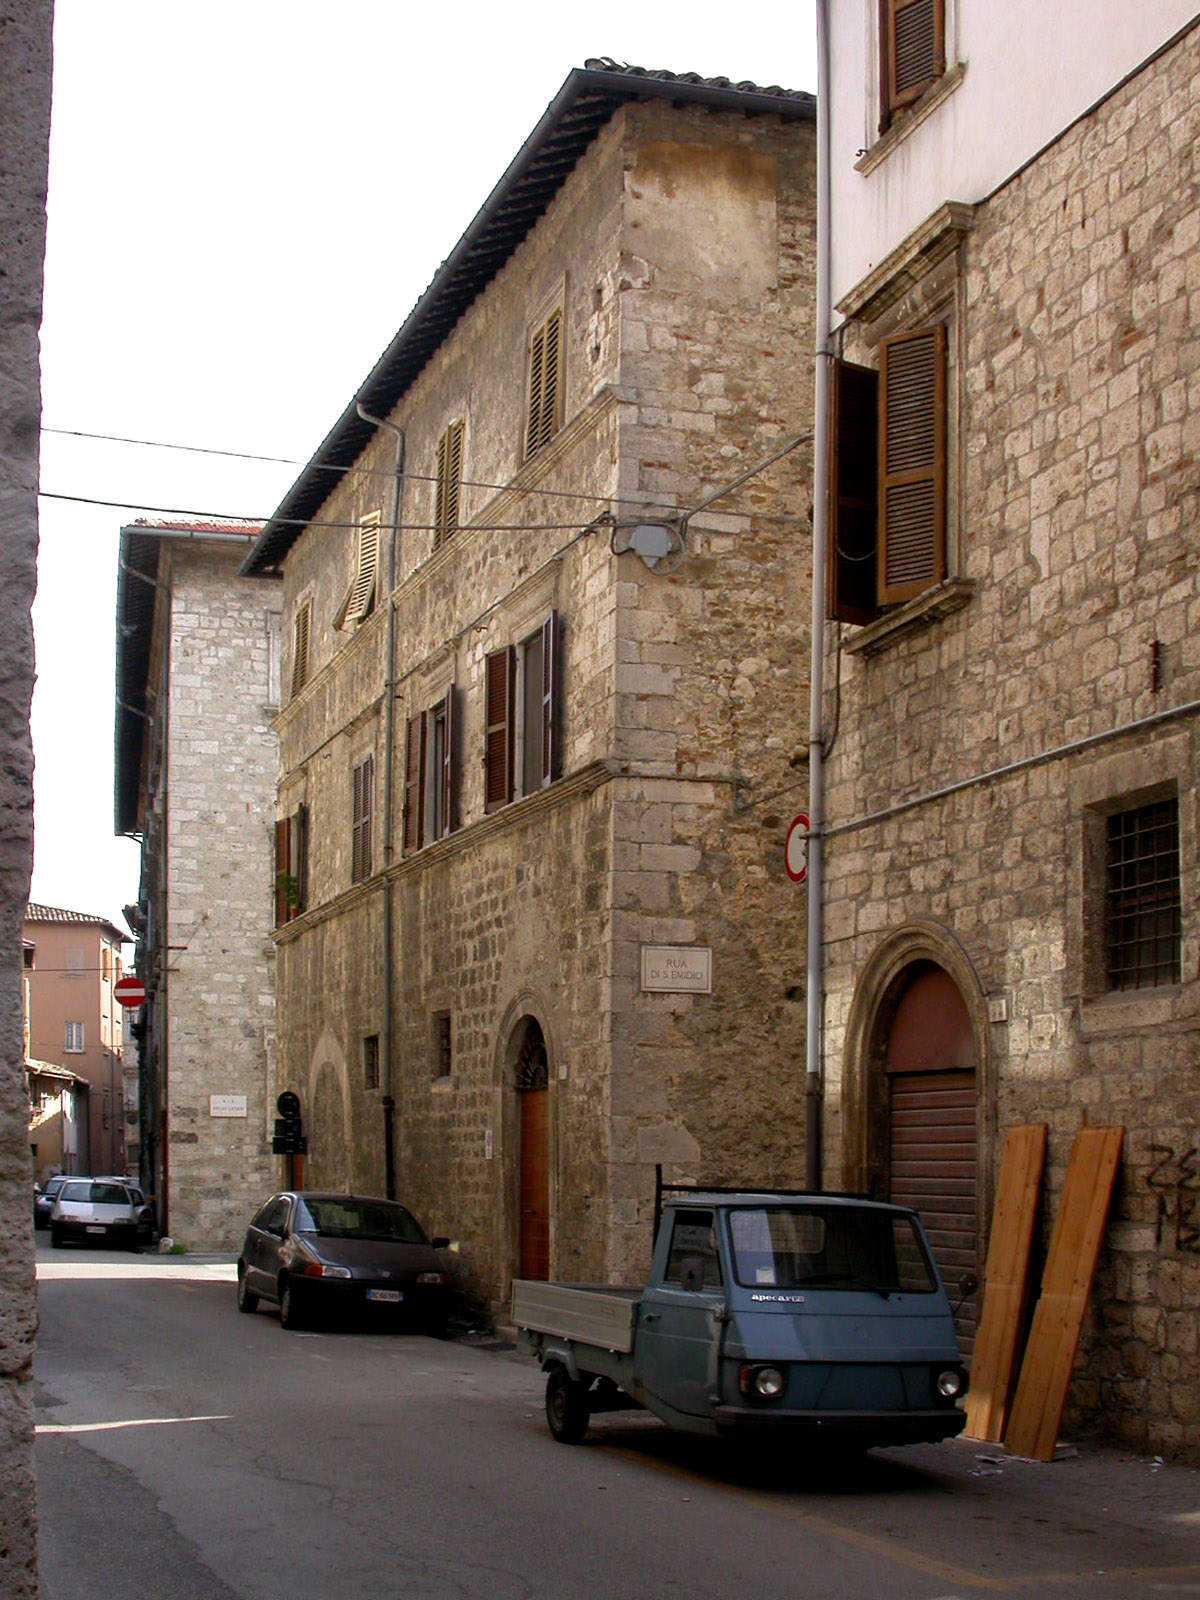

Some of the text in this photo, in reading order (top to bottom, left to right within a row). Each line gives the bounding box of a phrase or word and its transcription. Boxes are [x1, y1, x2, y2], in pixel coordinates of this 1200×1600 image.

[666, 959, 688, 968] RUA
[651, 970, 660, 978] DI
[671, 970, 703, 980] EMIDIO
